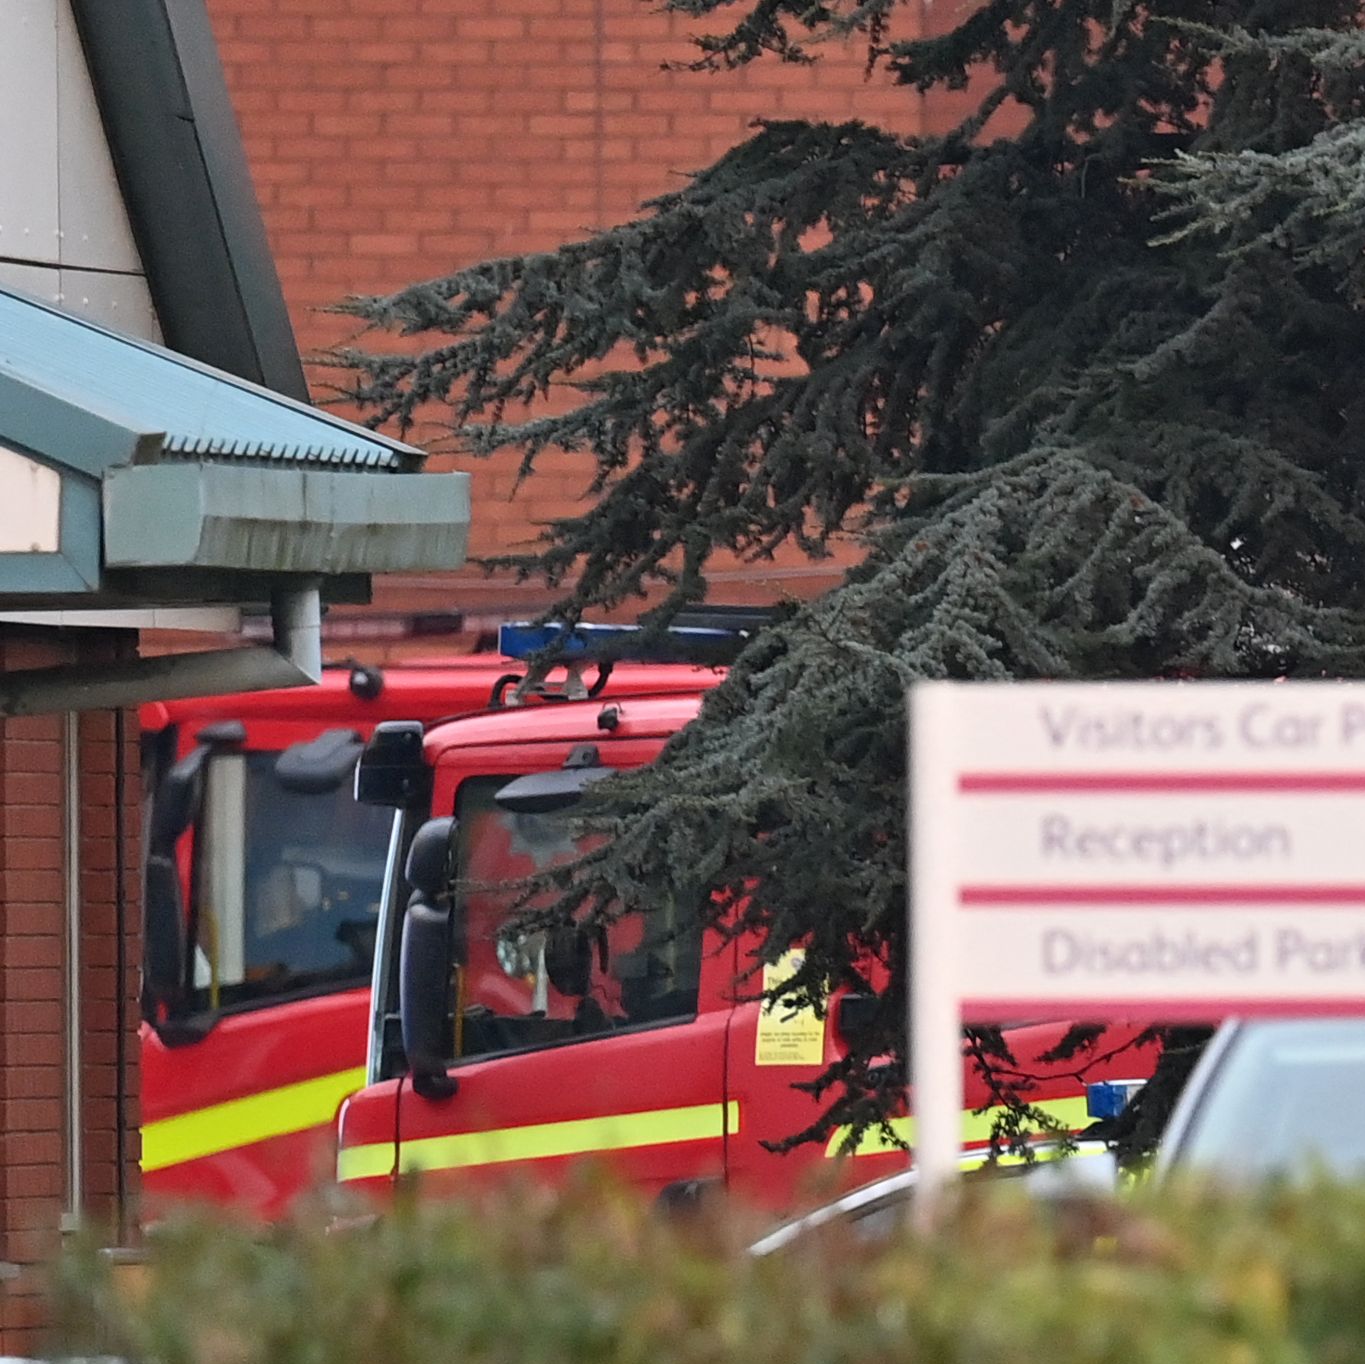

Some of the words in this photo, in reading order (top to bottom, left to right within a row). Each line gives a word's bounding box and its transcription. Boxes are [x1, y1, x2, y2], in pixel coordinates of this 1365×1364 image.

[1041, 704, 1223, 749] Visitors
[1240, 704, 1319, 749] Car
[1041, 816, 1292, 866] Reception
[1041, 930, 1258, 976] Disabled
